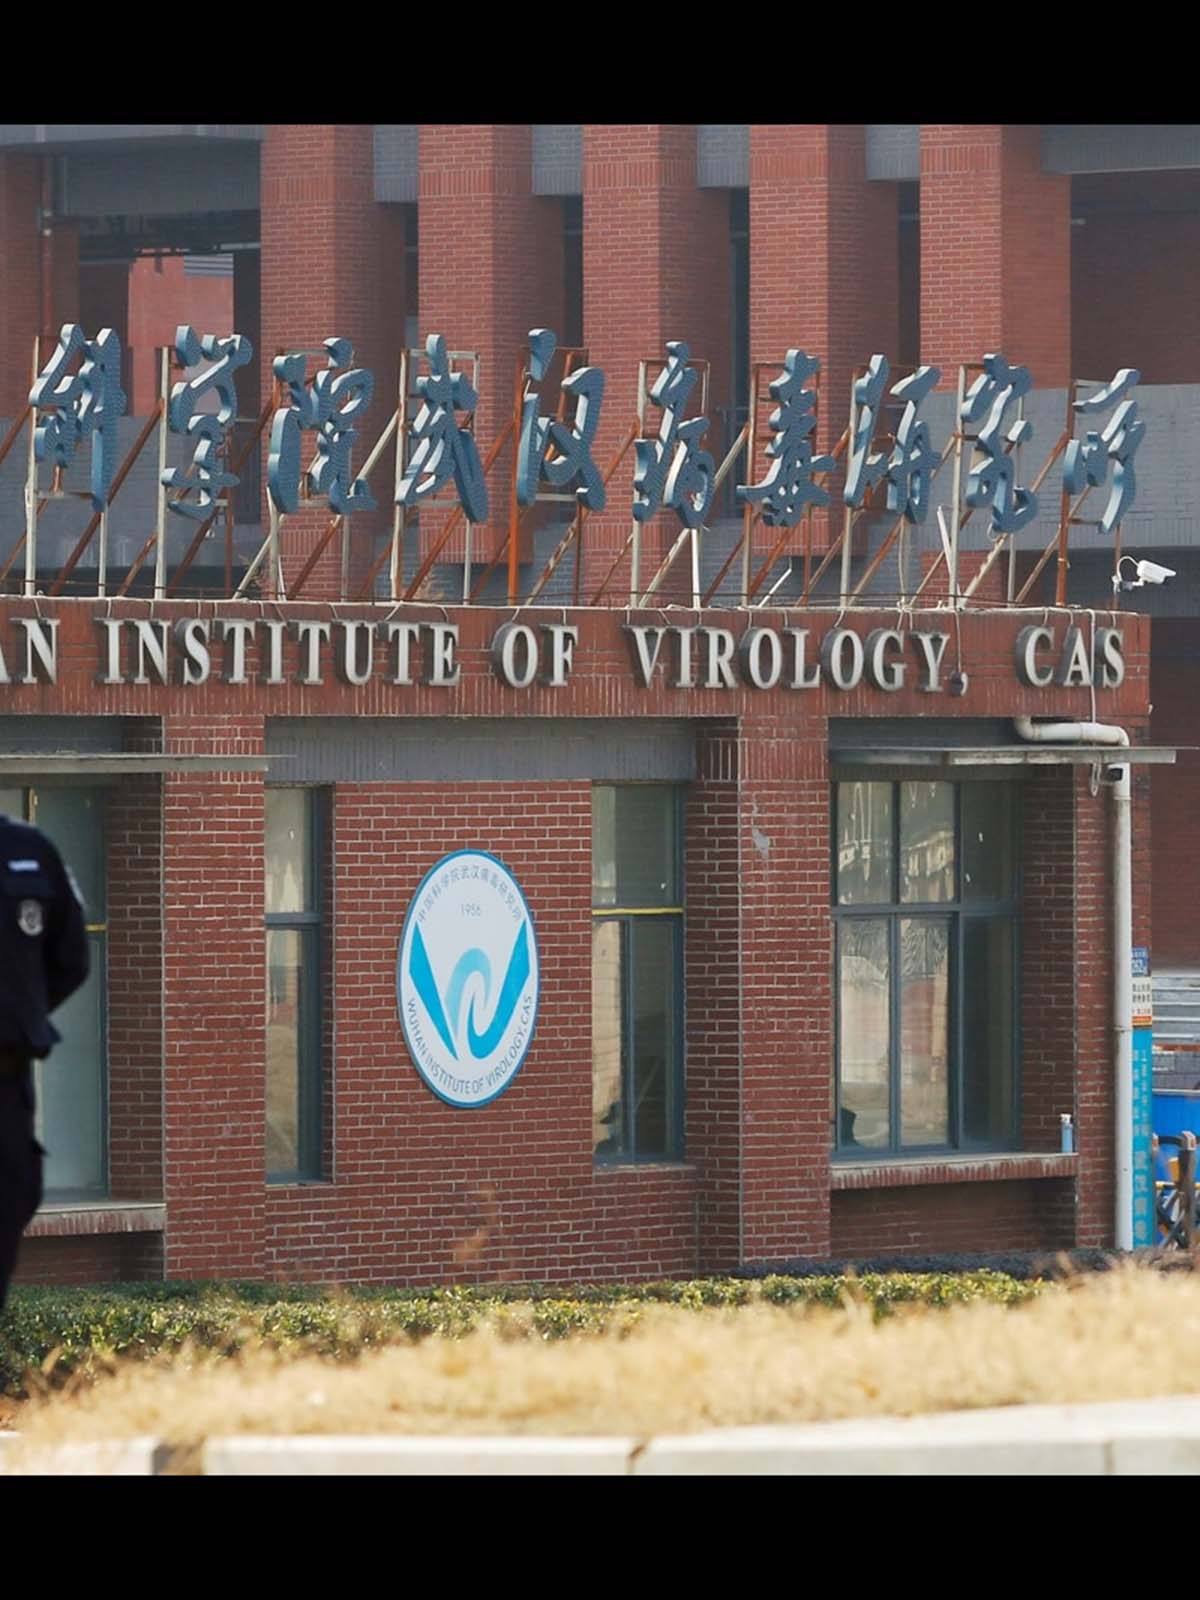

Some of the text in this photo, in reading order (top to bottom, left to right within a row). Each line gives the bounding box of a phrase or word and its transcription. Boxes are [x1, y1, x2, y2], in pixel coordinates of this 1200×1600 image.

[100, 616, 461, 688] INSTITUTE
[492, 623, 579, 690] OF
[628, 624, 969, 698] VIROLOGY,
[1016, 625, 1127, 690] CAS
[407, 997, 427, 1056] WUHAN
[425, 1055, 471, 1094] INSTITUTE
[472, 1078, 484, 1095] OF
